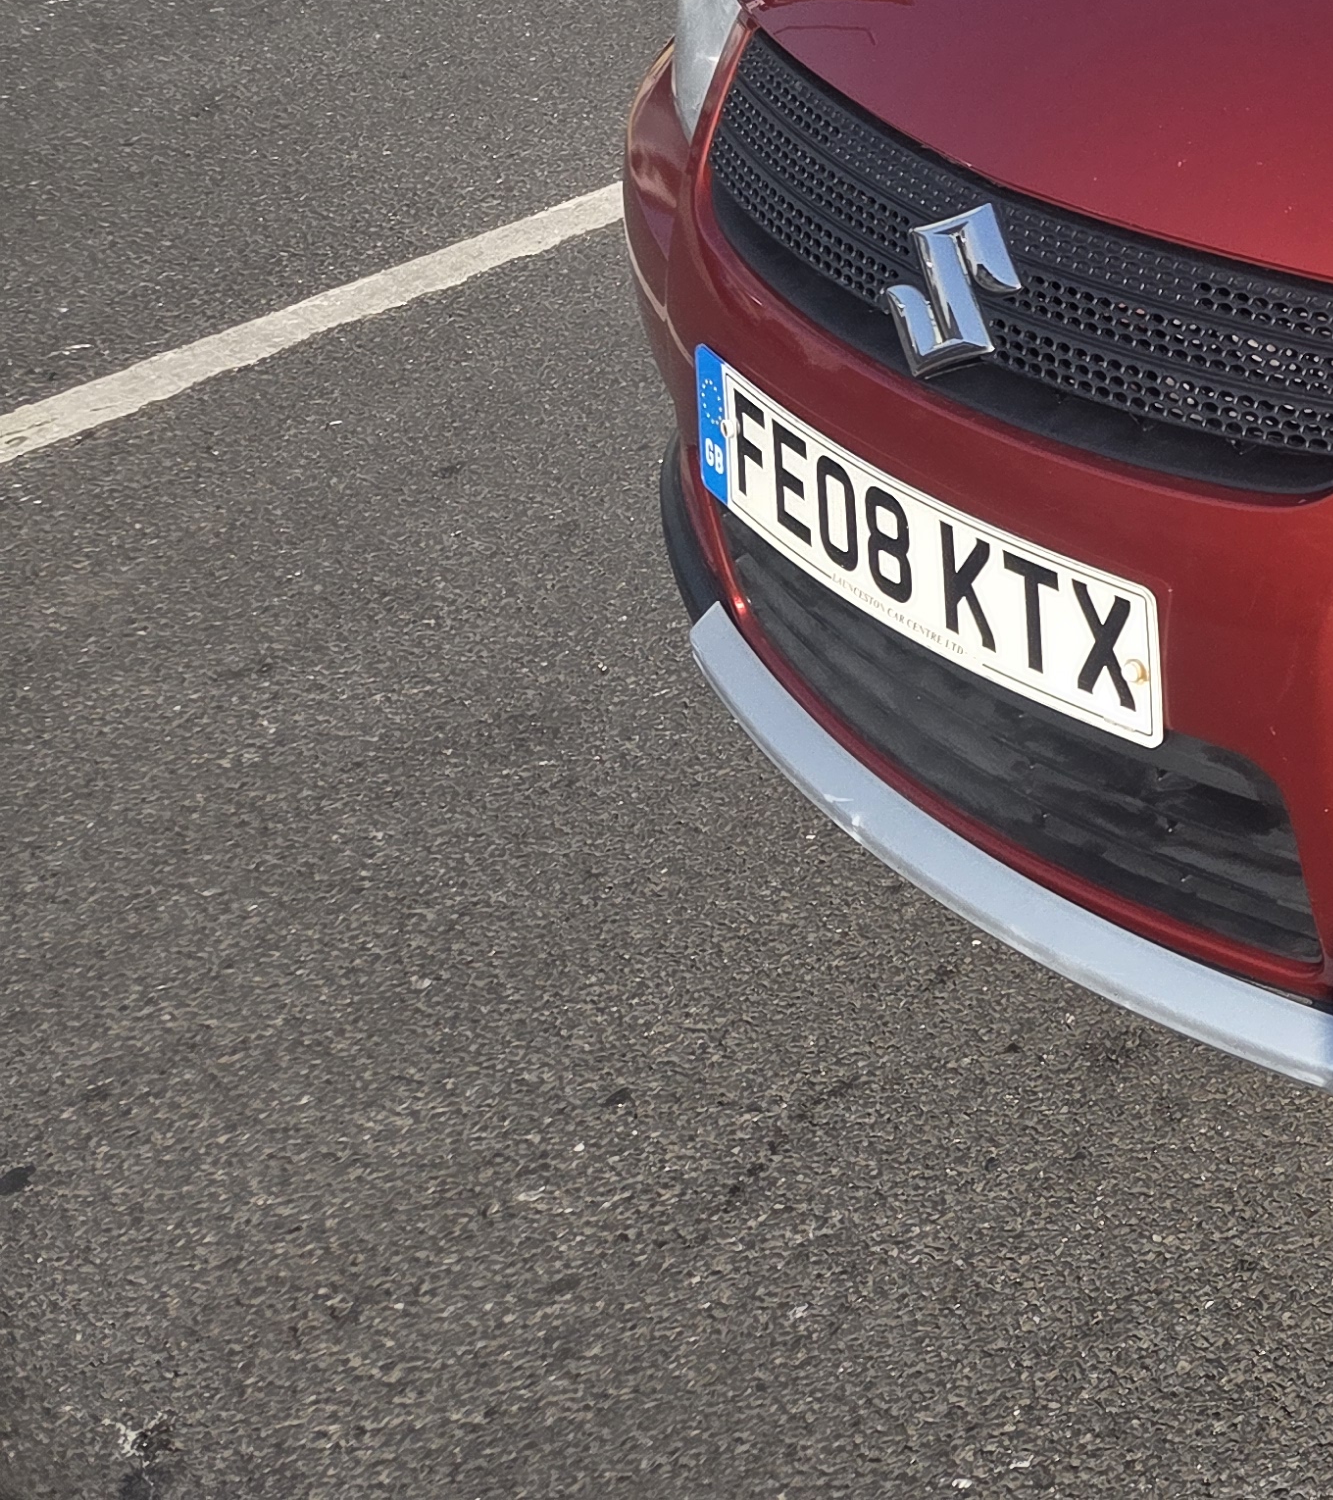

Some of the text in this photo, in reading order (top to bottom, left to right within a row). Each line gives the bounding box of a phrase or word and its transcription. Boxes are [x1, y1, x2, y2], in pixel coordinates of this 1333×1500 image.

[705, 437, 724, 474] GB
[733, 387, 1136, 713] FE08 KTX
[887, 607, 905, 624] CAR
[906, 618, 946, 645] CENTRE
[945, 638, 964, 655] LTD
